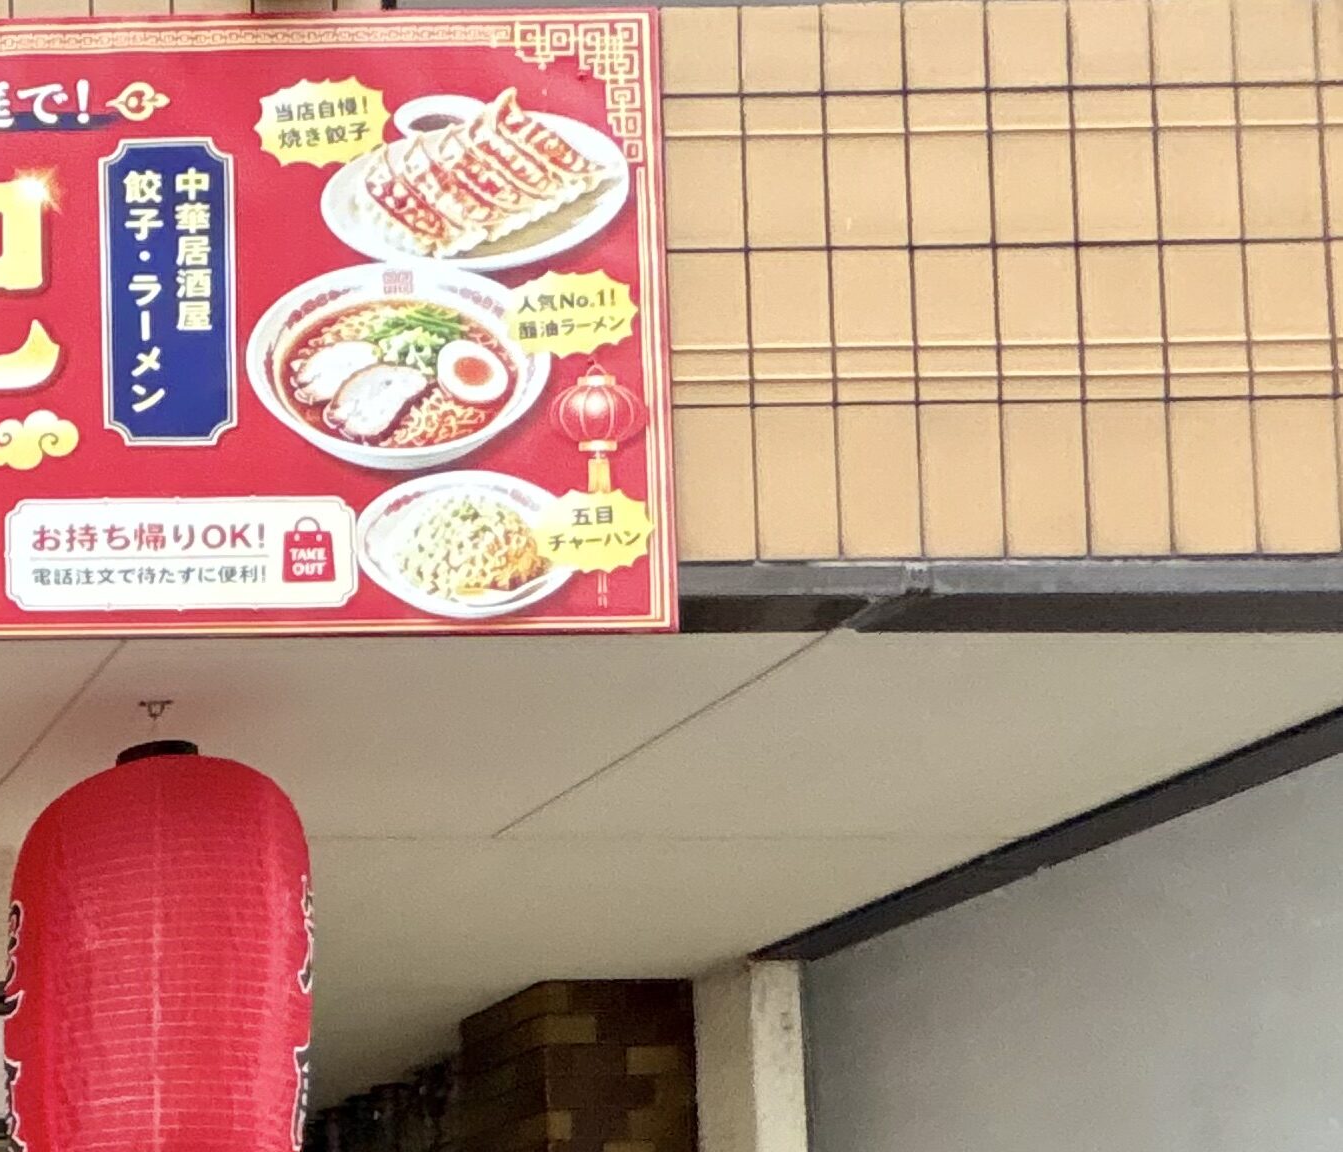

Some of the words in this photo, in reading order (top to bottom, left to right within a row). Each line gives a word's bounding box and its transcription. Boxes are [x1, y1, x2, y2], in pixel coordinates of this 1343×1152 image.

[277, 120, 371, 149] 焼き餃子
[174, 167, 213, 331] 中華居酒屋
[123, 169, 166, 413] 餃子・ラーメン
[571, 505, 614, 527] 五目
[31, 522, 266, 552] お持ち帰りOK!
[548, 530, 642, 552] チャーハン
[289, 546, 328, 561] TAKE
[31, 564, 267, 586] 電話注文で待たずに便利!
[291, 561, 326, 577] OUT
